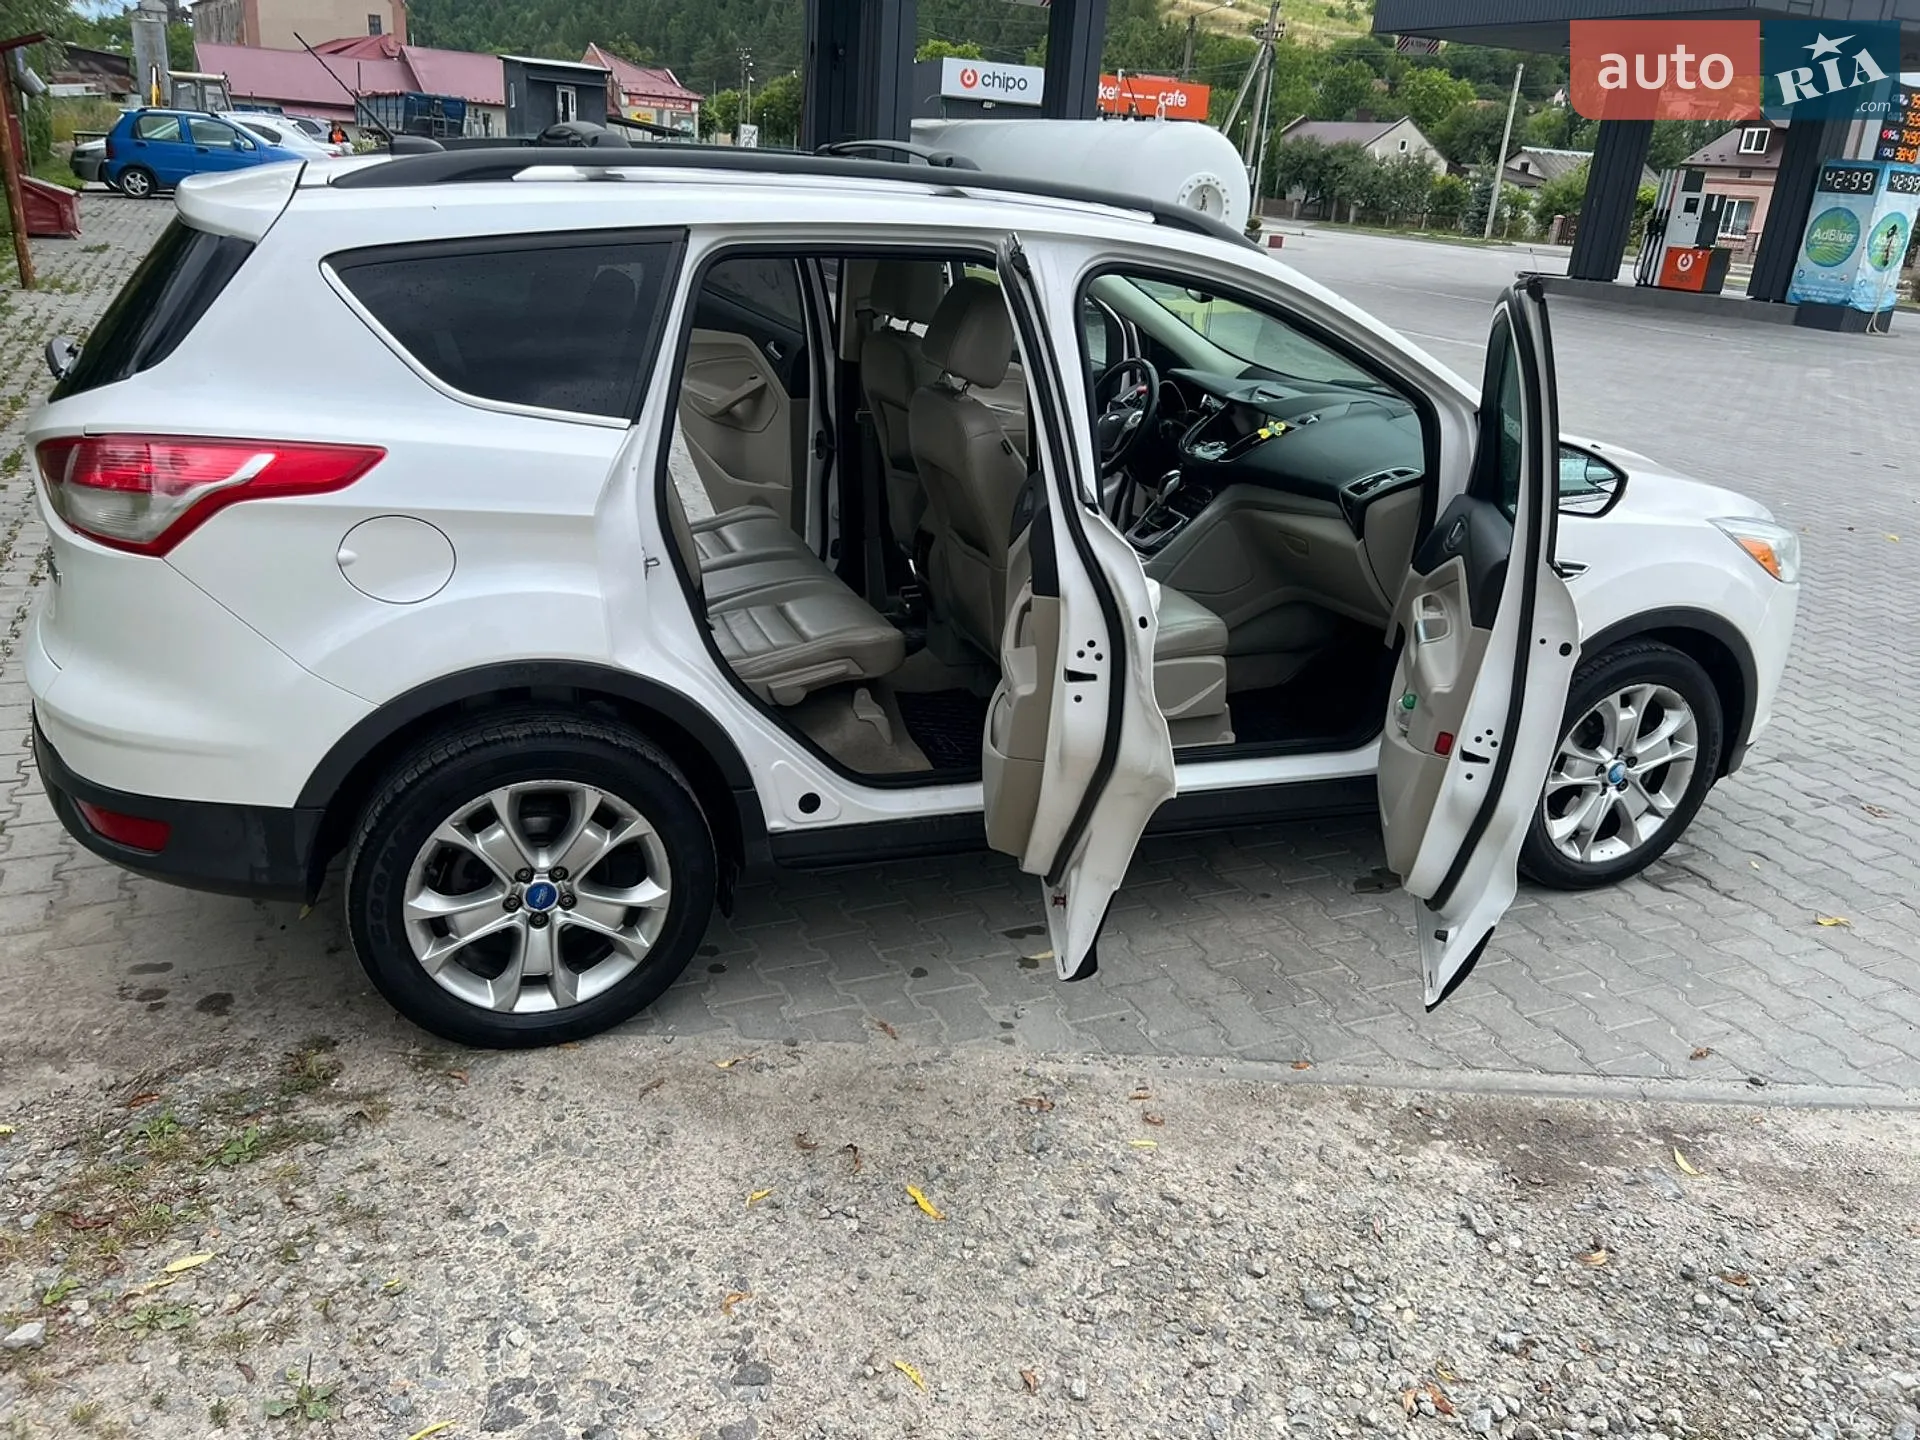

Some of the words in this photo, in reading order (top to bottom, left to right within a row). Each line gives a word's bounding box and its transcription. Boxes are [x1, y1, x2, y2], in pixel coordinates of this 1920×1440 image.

[981, 71, 1028, 92] chipo
[1158, 89, 1187, 107] cafe
[1825, 171, 1873, 191] 42:99
[1811, 228, 1854, 243] AdBlue
